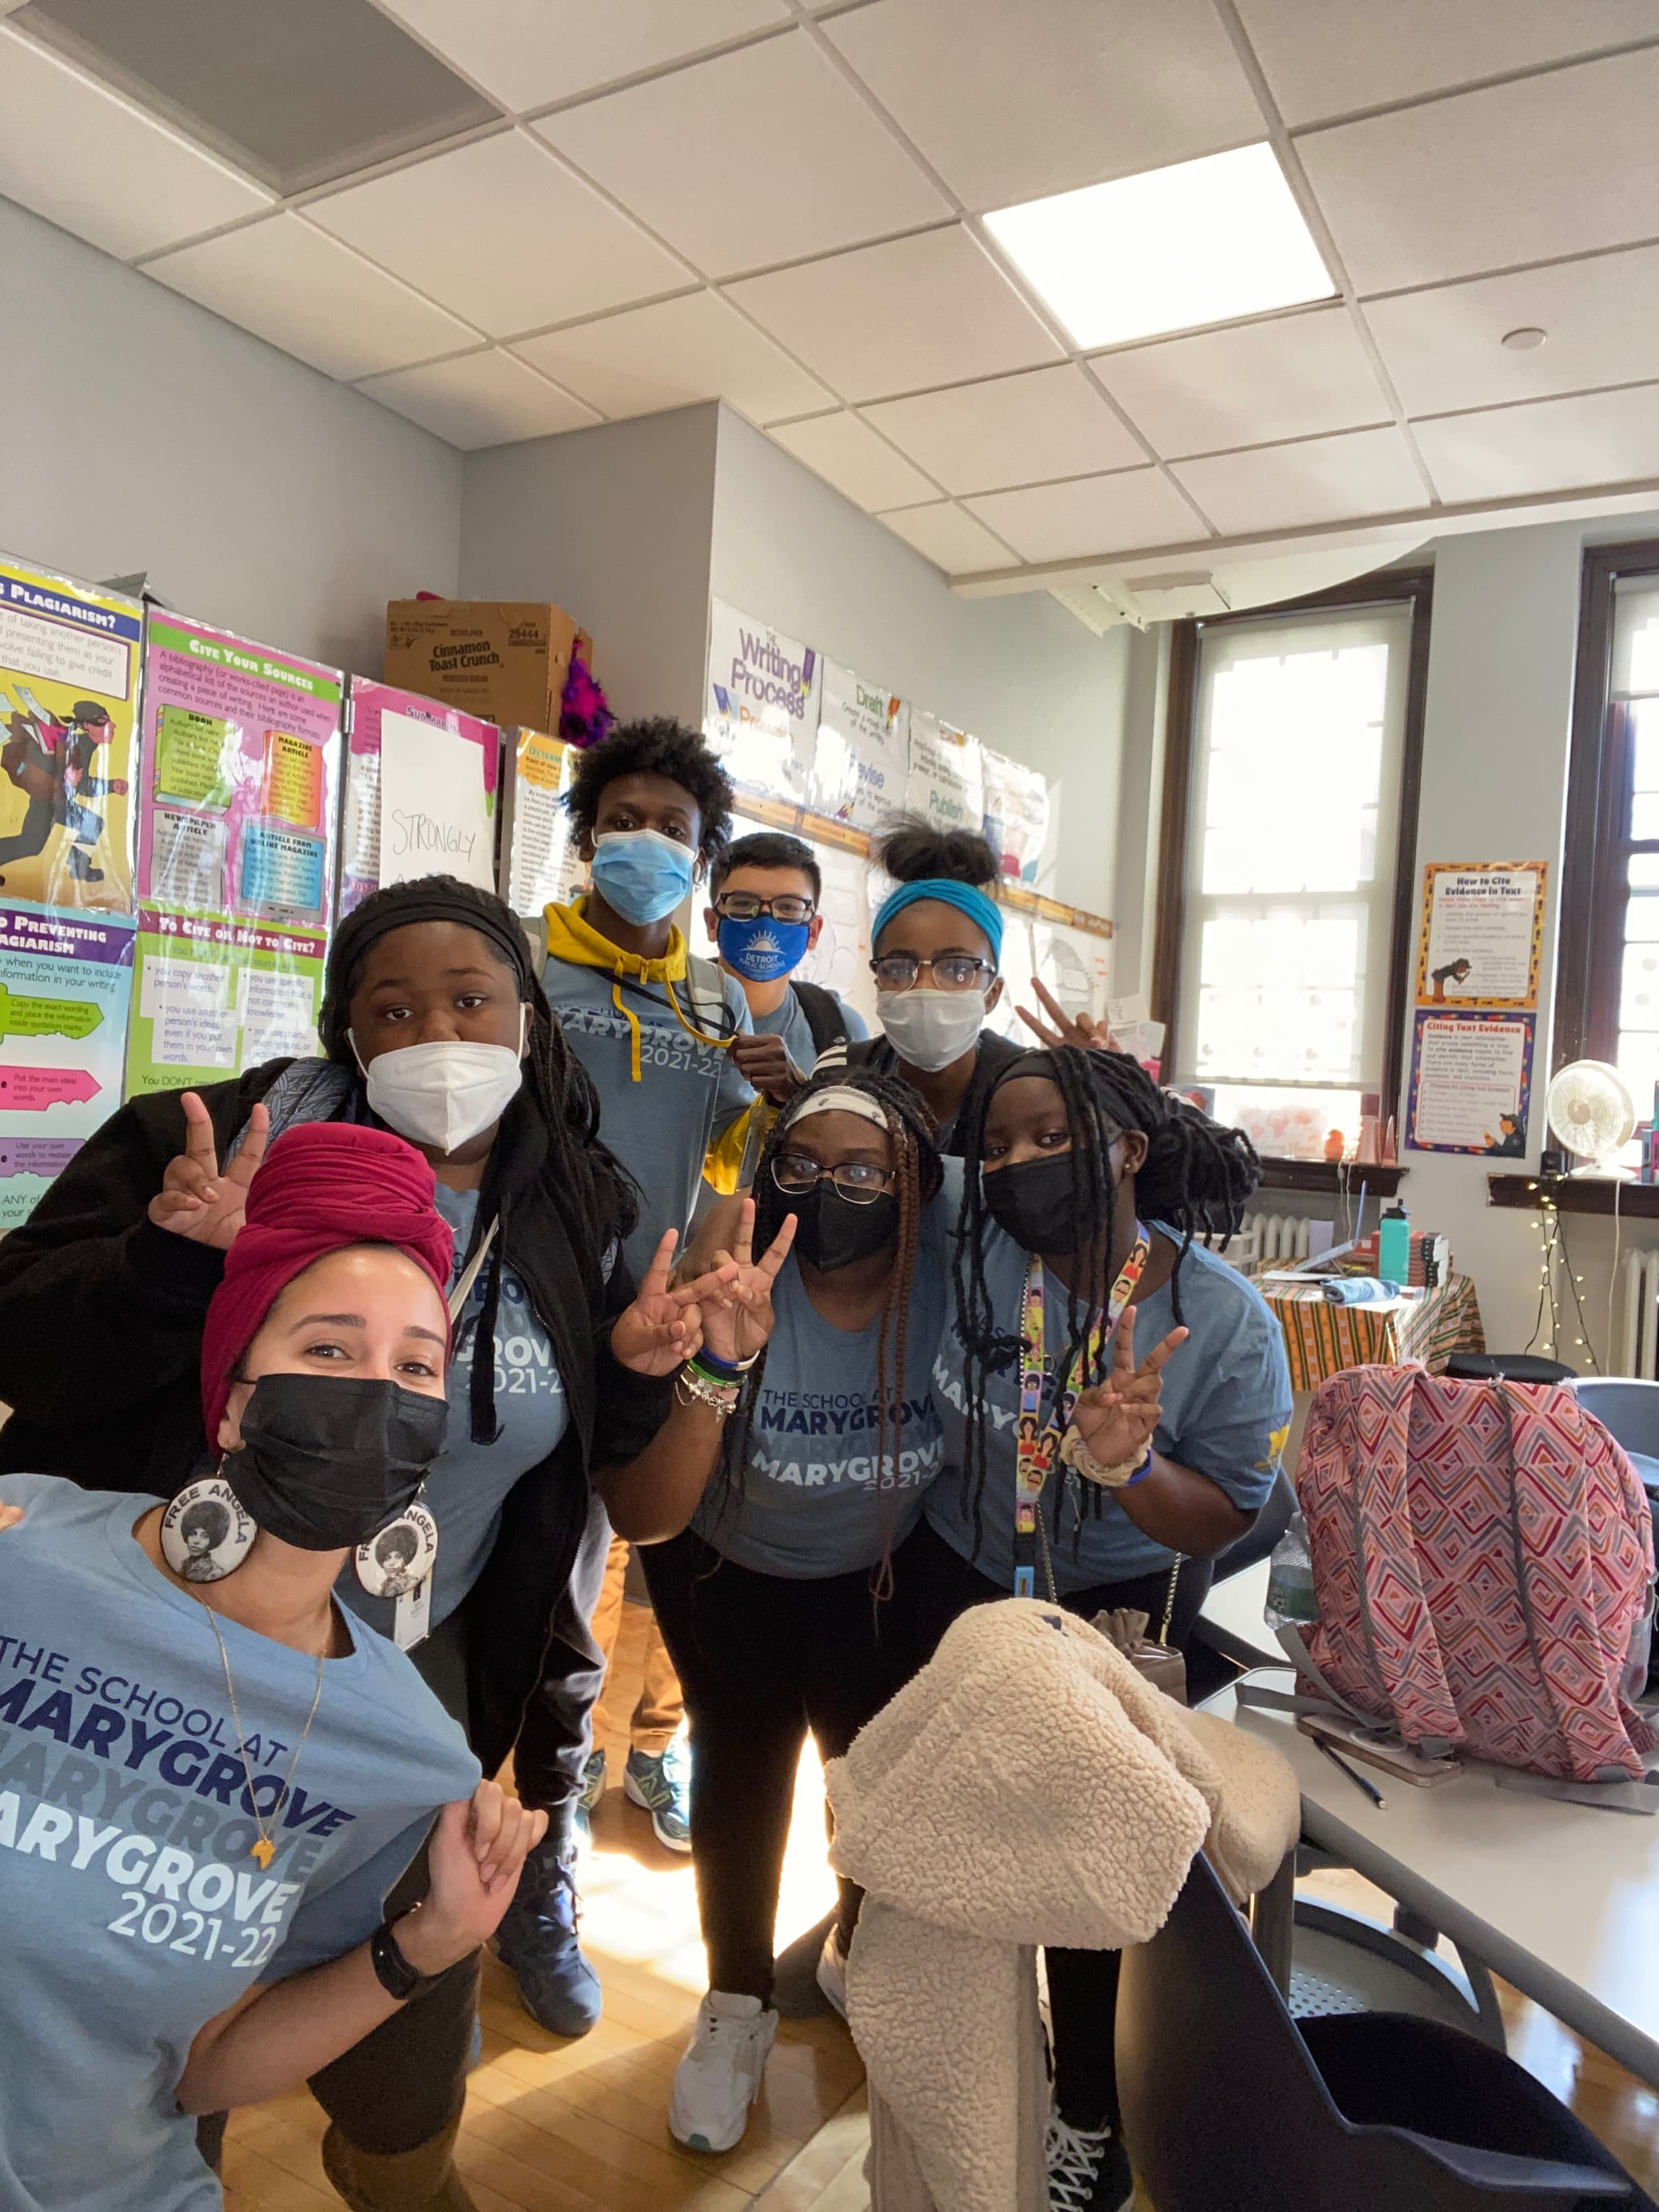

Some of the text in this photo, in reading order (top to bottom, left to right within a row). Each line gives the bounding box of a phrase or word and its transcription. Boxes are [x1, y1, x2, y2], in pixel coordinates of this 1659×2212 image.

[10, 584, 116, 629] PLAGIARISM?
[20, 618, 46, 635] taking
[50, 627, 84, 643] another
[509, 629, 539, 638] 29444
[6, 628, 115, 665] presenting them your
[433, 641, 490, 658] Cinnamon
[2, 653, 40, 672] that you
[27, 645, 112, 678] failing to give credit
[159, 650, 167, 660] A
[169, 653, 214, 675] bibliography
[190, 639, 313, 691] CITE YOUR SOURCES
[429, 652, 500, 672] Toast Crunch
[739, 627, 802, 693] Writing
[159, 662, 315, 717] alphabetical of the sources author used
[731, 657, 805, 720] Process
[159, 674, 307, 725] creating piece Here some
[857, 684, 883, 717] Draft
[159, 684, 296, 733] common sources and their bibliography
[189, 714, 212, 725] BOOK
[278, 735, 312, 751] MAGAZINE
[282, 745, 308, 759] ARTICLE
[164, 813, 216, 830] NEWPAPER
[173, 823, 207, 836] ATICLE
[292, 840, 312, 849] FROM
[392, 809, 476, 863] STRONGLY
[280, 844, 318, 858] MAGAZINE
[14, 916, 107, 943] PREVENTING
[159, 917, 316, 954] TO CITE OR NOT TO CITE?
[746, 952, 779, 963] DETROIT
[759, 960, 785, 969] SCHOOLS
[6, 957, 121, 979] when you want to include
[173, 970, 191, 979] copy
[54, 975, 84, 987] in your
[12, 998, 29, 1008] Copy
[64, 1006, 88, 1014] wording
[25, 1010, 41, 1019] place
[57, 1014, 92, 1022] information
[165, 1018, 197, 1027] person's
[30, 1020, 62, 1030] quotation
[1427, 1022, 1453, 1032] Citing
[1479, 1024, 1520, 1033] Evidence
[164, 1041, 184, 1049] them
[210, 1033, 222, 1041] put
[640, 1045, 722, 1078] 2021-22
[143, 1076, 193, 1086] You DON'T
[3, 1196, 26, 1205] ANY
[2, 1209, 24, 1219] your
[763, 1390, 797, 1407] THE
[165, 1484, 249, 1544] FREE ANGELA
[0, 1636, 288, 1767] THE SCHOOL AT
[108, 1892, 276, 1967] 2021-22
